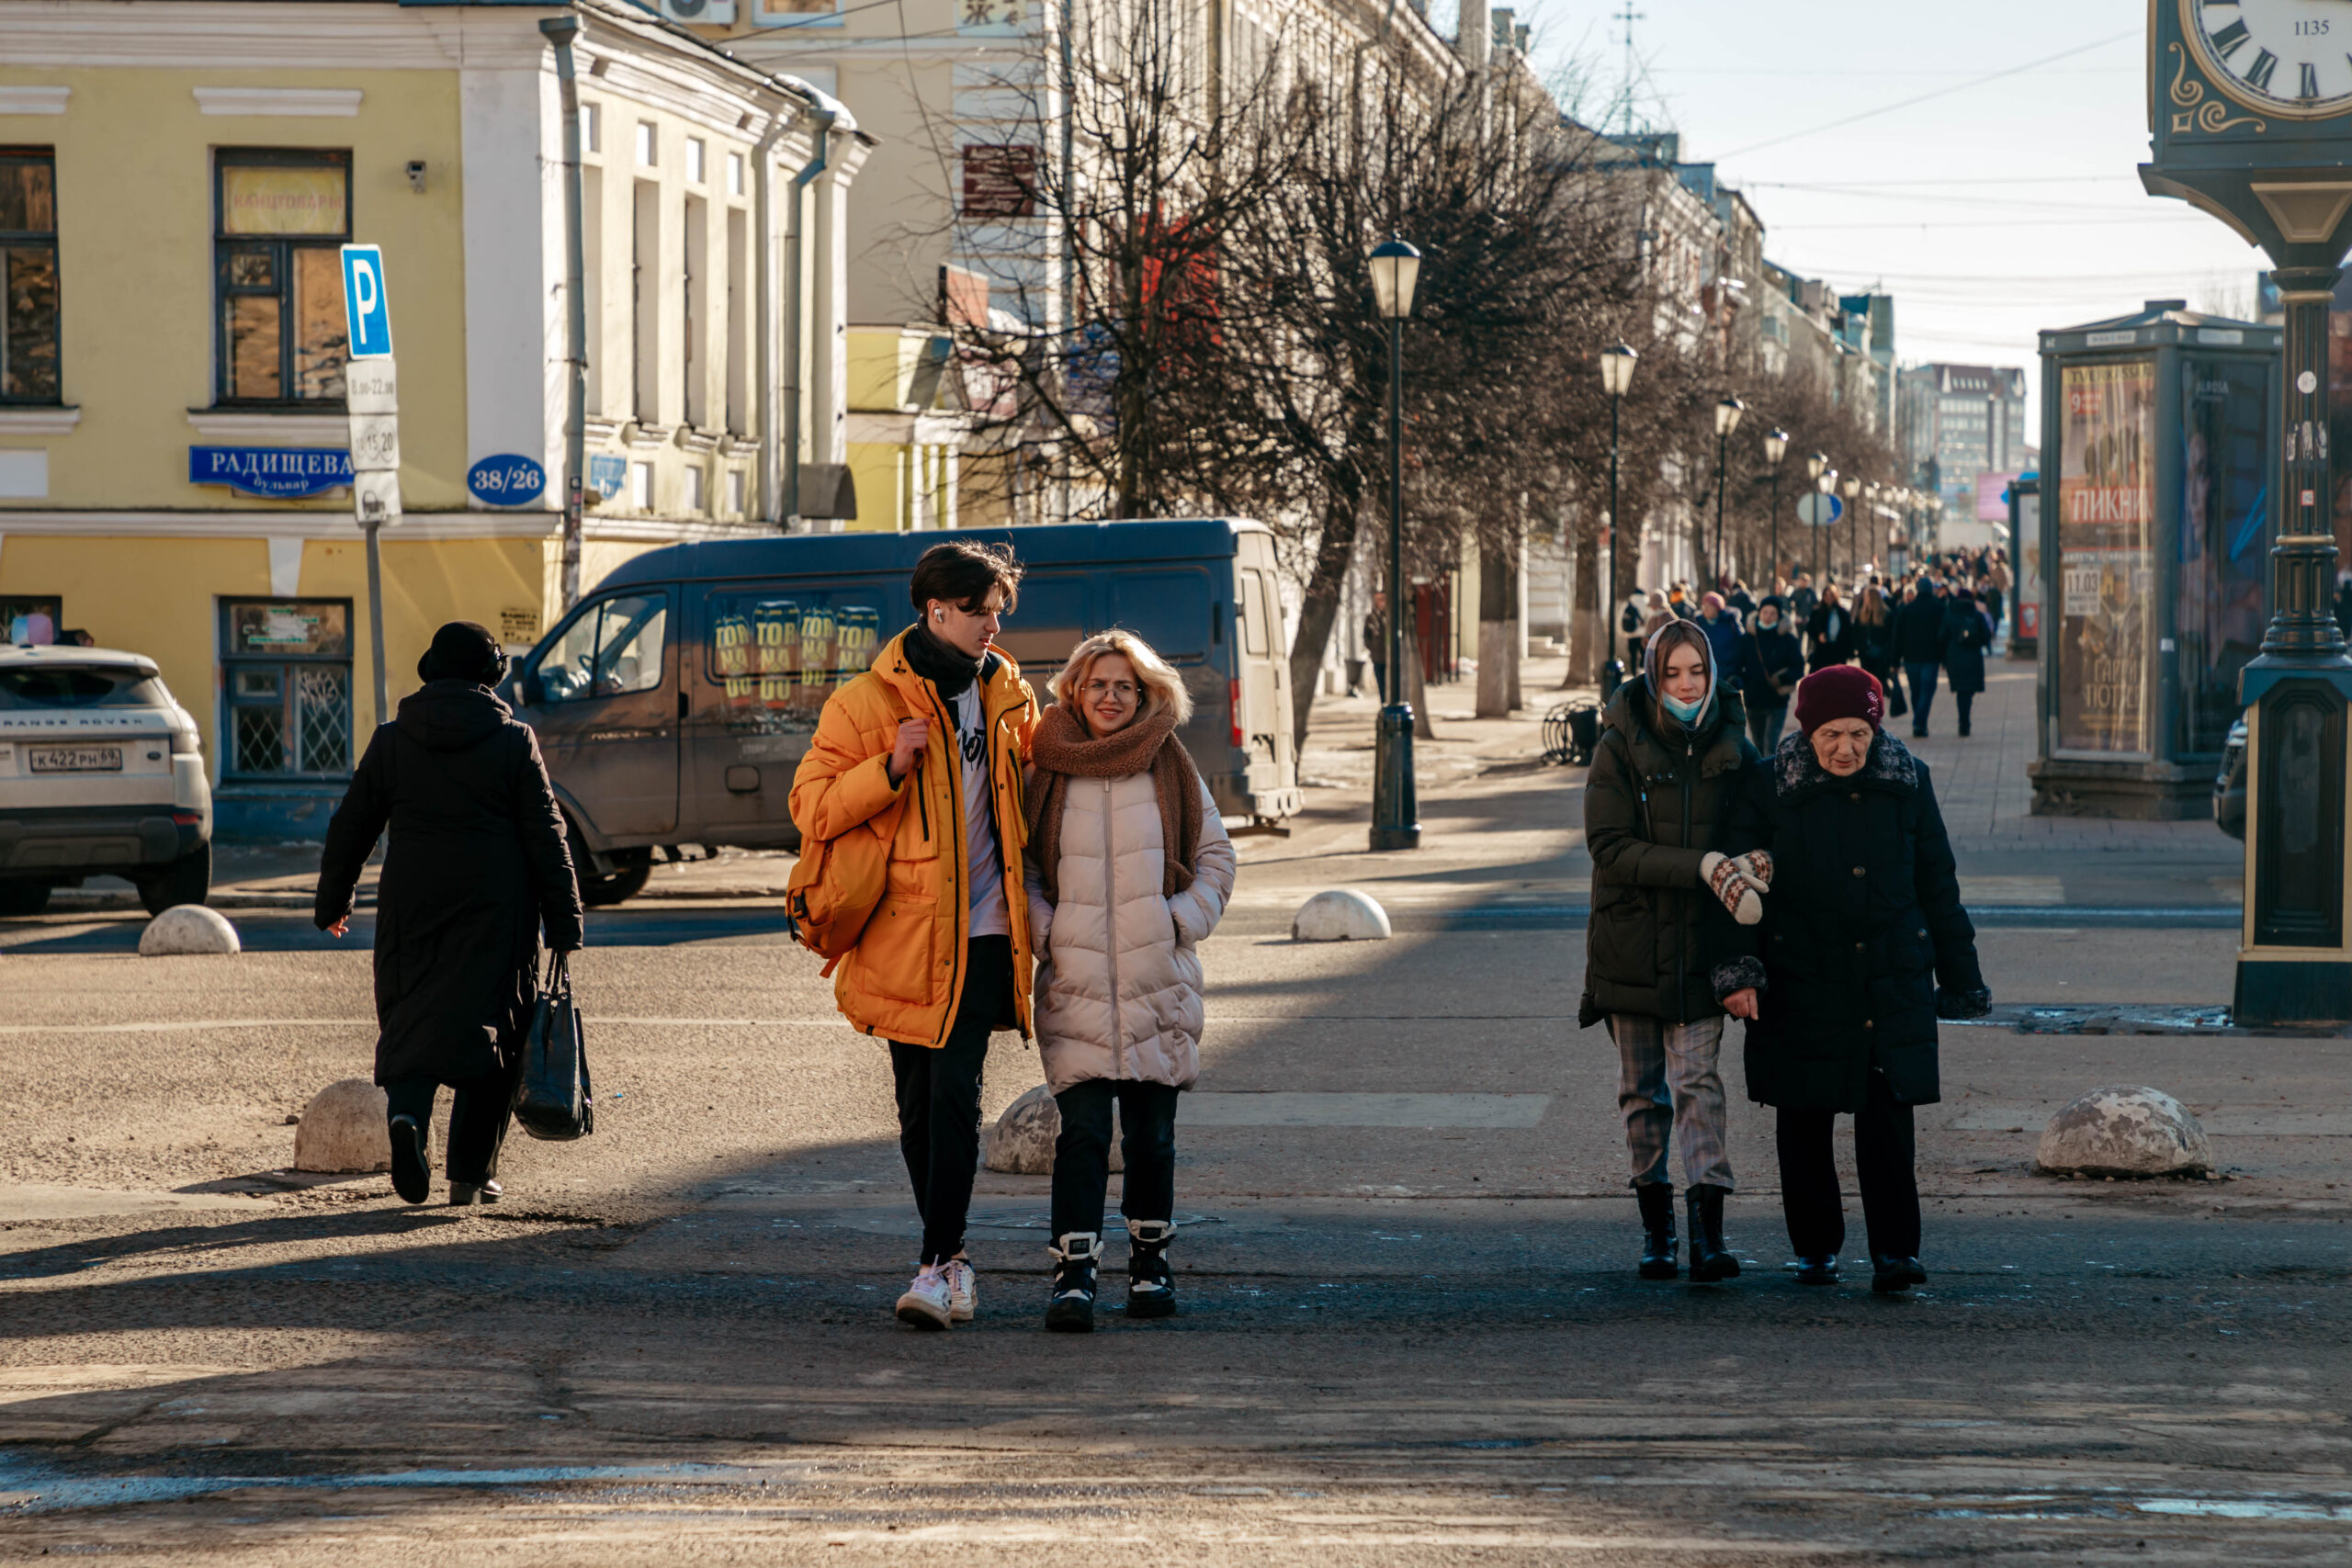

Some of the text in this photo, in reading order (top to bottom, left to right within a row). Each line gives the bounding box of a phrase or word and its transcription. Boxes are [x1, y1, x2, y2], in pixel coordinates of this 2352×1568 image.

[2294, 20, 2330, 36] 1135
[233, 194, 344, 210] КАНЦТОВАРЫ
[352, 259, 378, 345] P
[380, 433, 394, 452] 20
[211, 452, 356, 478] РАДИЩЕВА
[254, 477, 309, 493] бульвар
[474, 465, 540, 494] 38/26
[2067, 572, 2098, 593] 11.03
[716, 624, 751, 649] TOR
[756, 622, 797, 646] TOR
[2086, 682, 2143, 709] ПОТЕ
